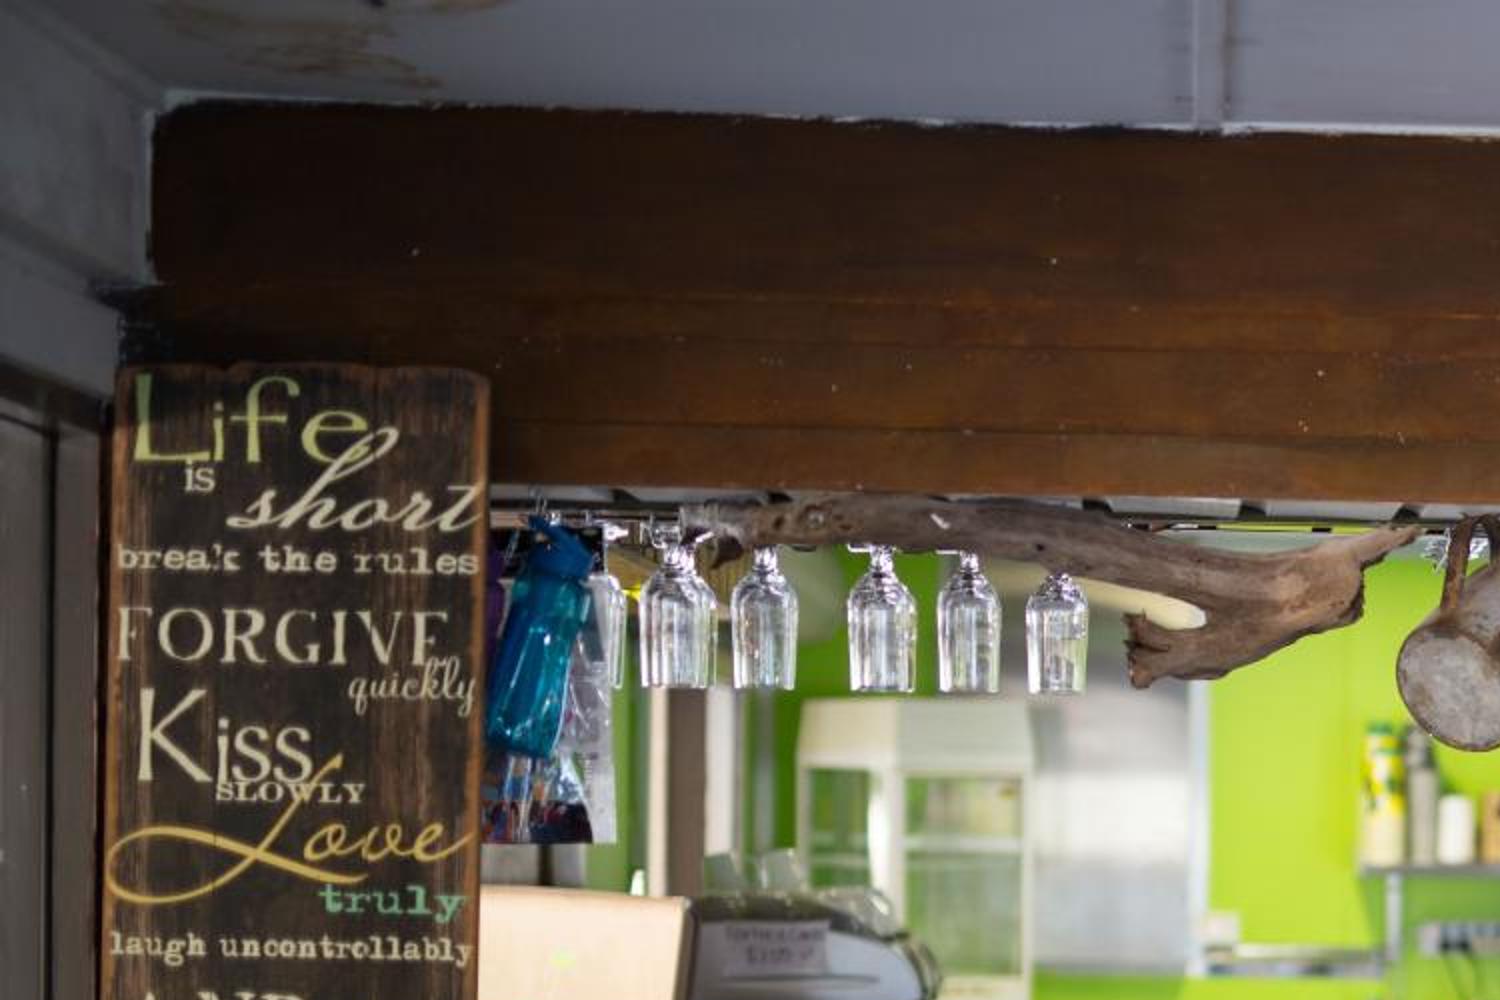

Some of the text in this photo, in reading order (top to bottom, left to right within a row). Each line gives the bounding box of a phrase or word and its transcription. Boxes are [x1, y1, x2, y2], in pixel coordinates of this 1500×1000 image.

[134, 373, 369, 466] Life
[184, 459, 216, 492] is
[226, 426, 483, 532] short
[117, 544, 480, 576] break the rules
[116, 607, 449, 667] FORGIVE
[348, 656, 477, 717] quickly
[137, 688, 313, 783] Kiss
[215, 780, 366, 803] SLOWLY
[105, 753, 473, 903] Love
[320, 884, 466, 923] truly
[110, 932, 473, 968] laugh uncontrollably
